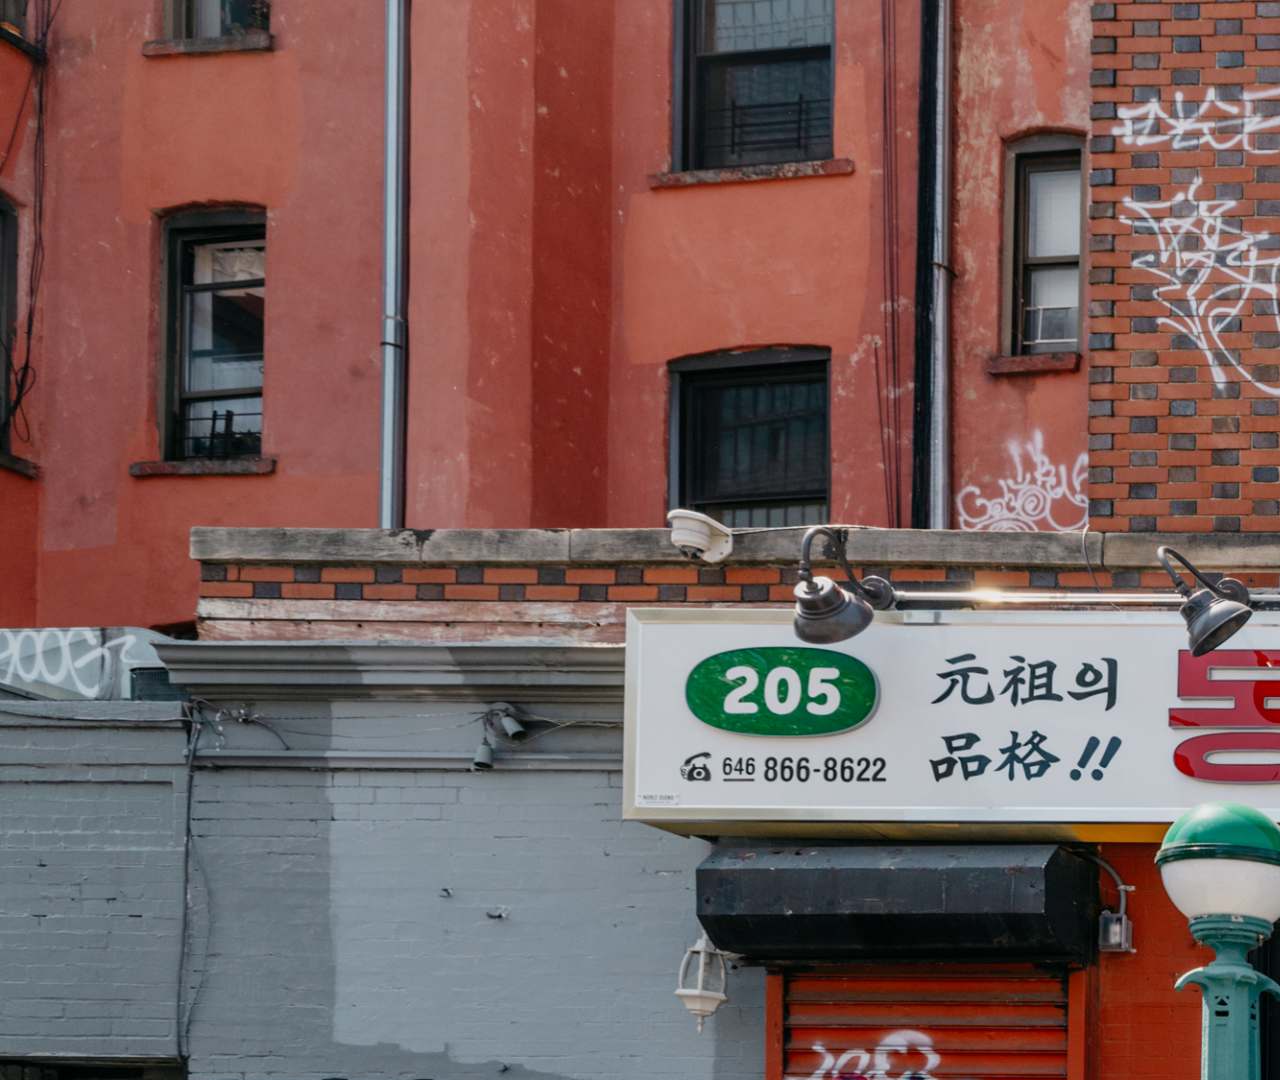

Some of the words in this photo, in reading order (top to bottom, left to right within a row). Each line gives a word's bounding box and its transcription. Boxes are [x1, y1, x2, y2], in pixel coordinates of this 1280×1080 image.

[723, 666, 842, 715] 205
[931, 653, 1119, 711] 元祖의
[722, 756, 755, 780] 646
[763, 757, 887, 783] 866-8622
